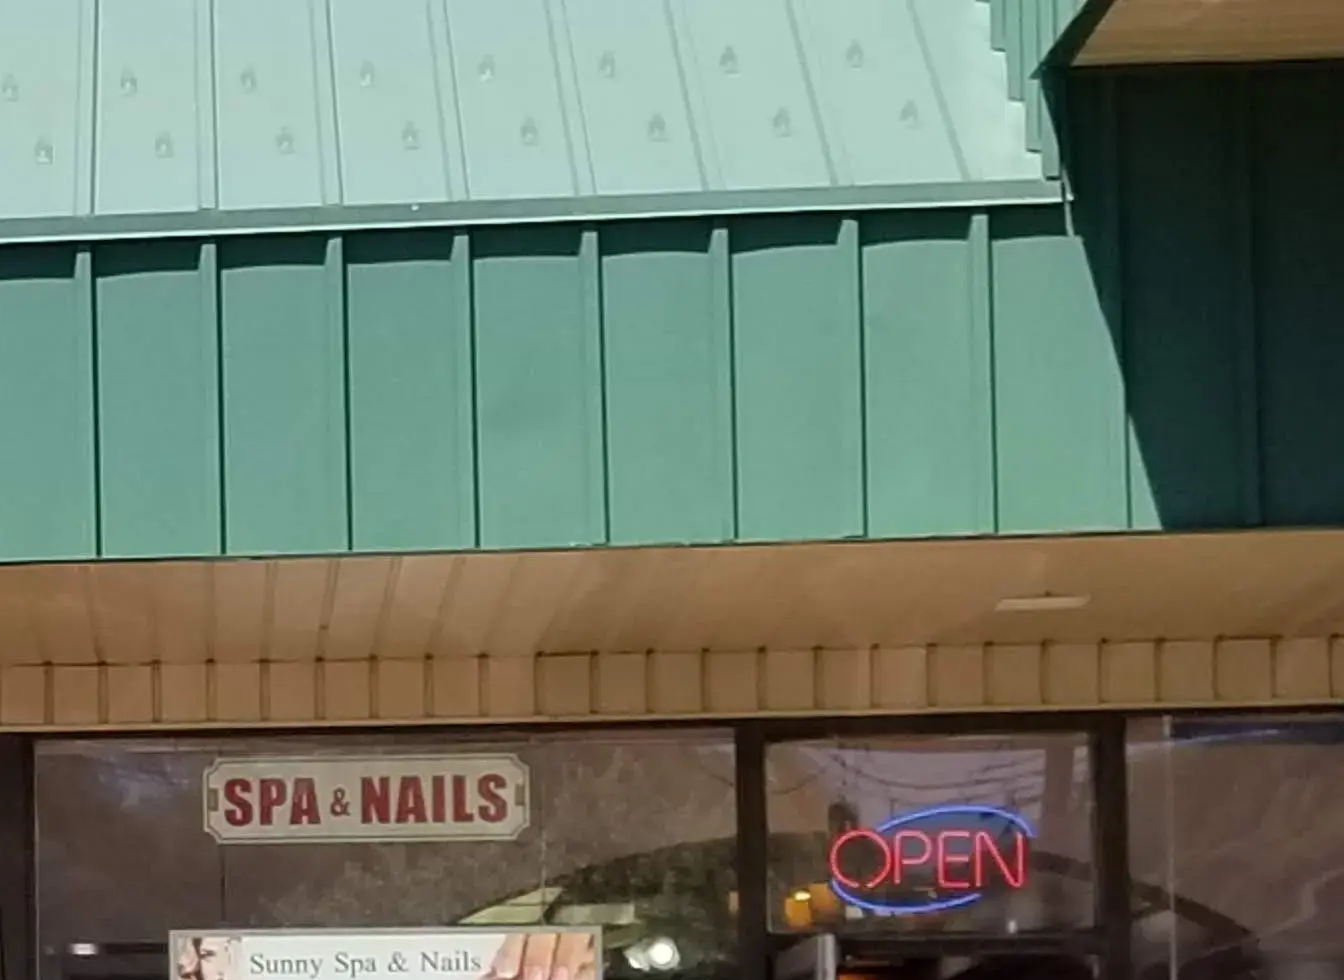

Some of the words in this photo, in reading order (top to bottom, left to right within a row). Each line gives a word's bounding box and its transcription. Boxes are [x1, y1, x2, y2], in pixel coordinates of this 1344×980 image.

[224, 776, 321, 827] SPA
[330, 787, 351, 817] &
[360, 773, 508, 824] NAILS
[828, 828, 1026, 889] OPEN
[249, 953, 323, 978] Sunny
[334, 952, 377, 978] Spa
[387, 952, 409, 972] &
[420, 951, 482, 972] Nails
